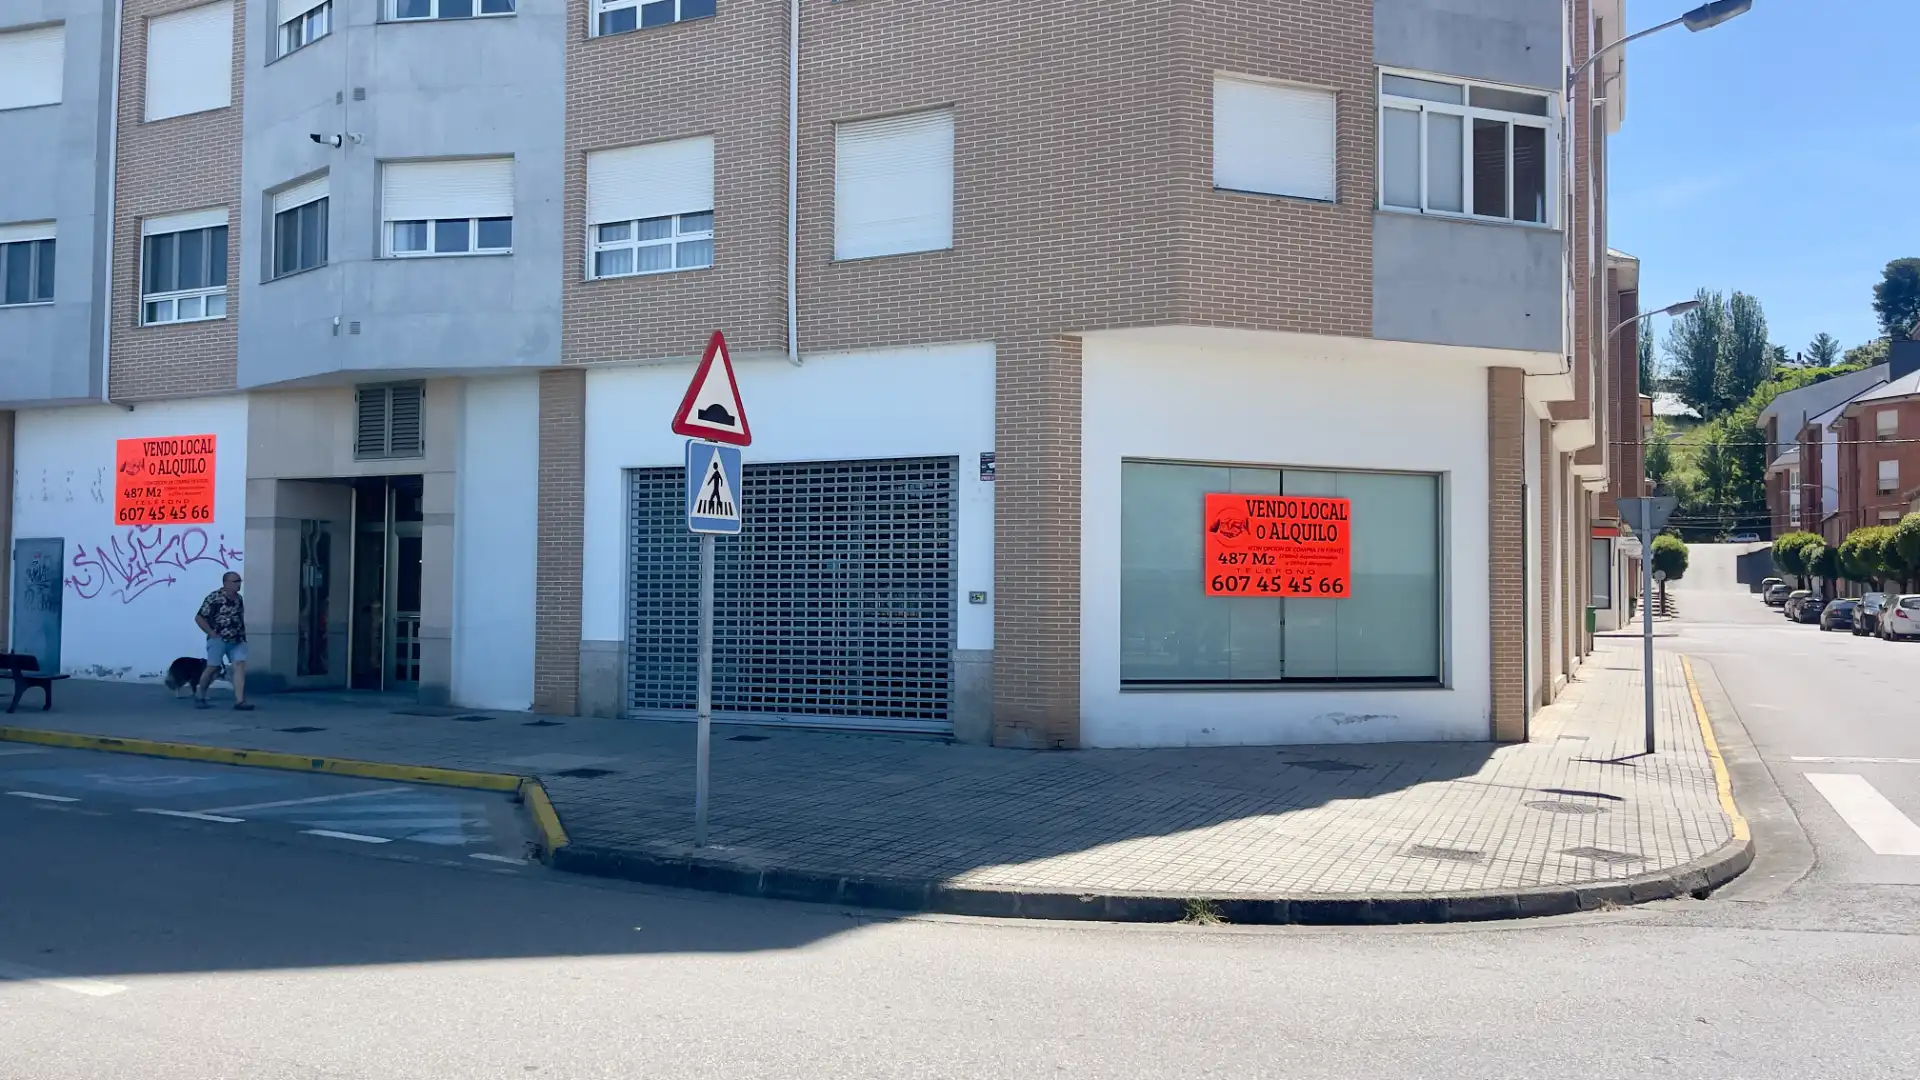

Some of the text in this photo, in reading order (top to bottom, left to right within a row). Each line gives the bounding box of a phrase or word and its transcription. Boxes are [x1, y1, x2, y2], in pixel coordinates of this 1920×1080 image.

[143, 438, 214, 457] VENDO LOCAL
[157, 457, 206, 477] ALQUILO
[123, 487, 143, 499] 487
[119, 504, 210, 521] 607 45 45 66
[1245, 499, 1348, 521] VENDO LOCAL
[1269, 522, 1338, 545] ALQUILO
[1218, 552, 1248, 565] 487
[1212, 575, 1344, 594] 607 45 45 66
